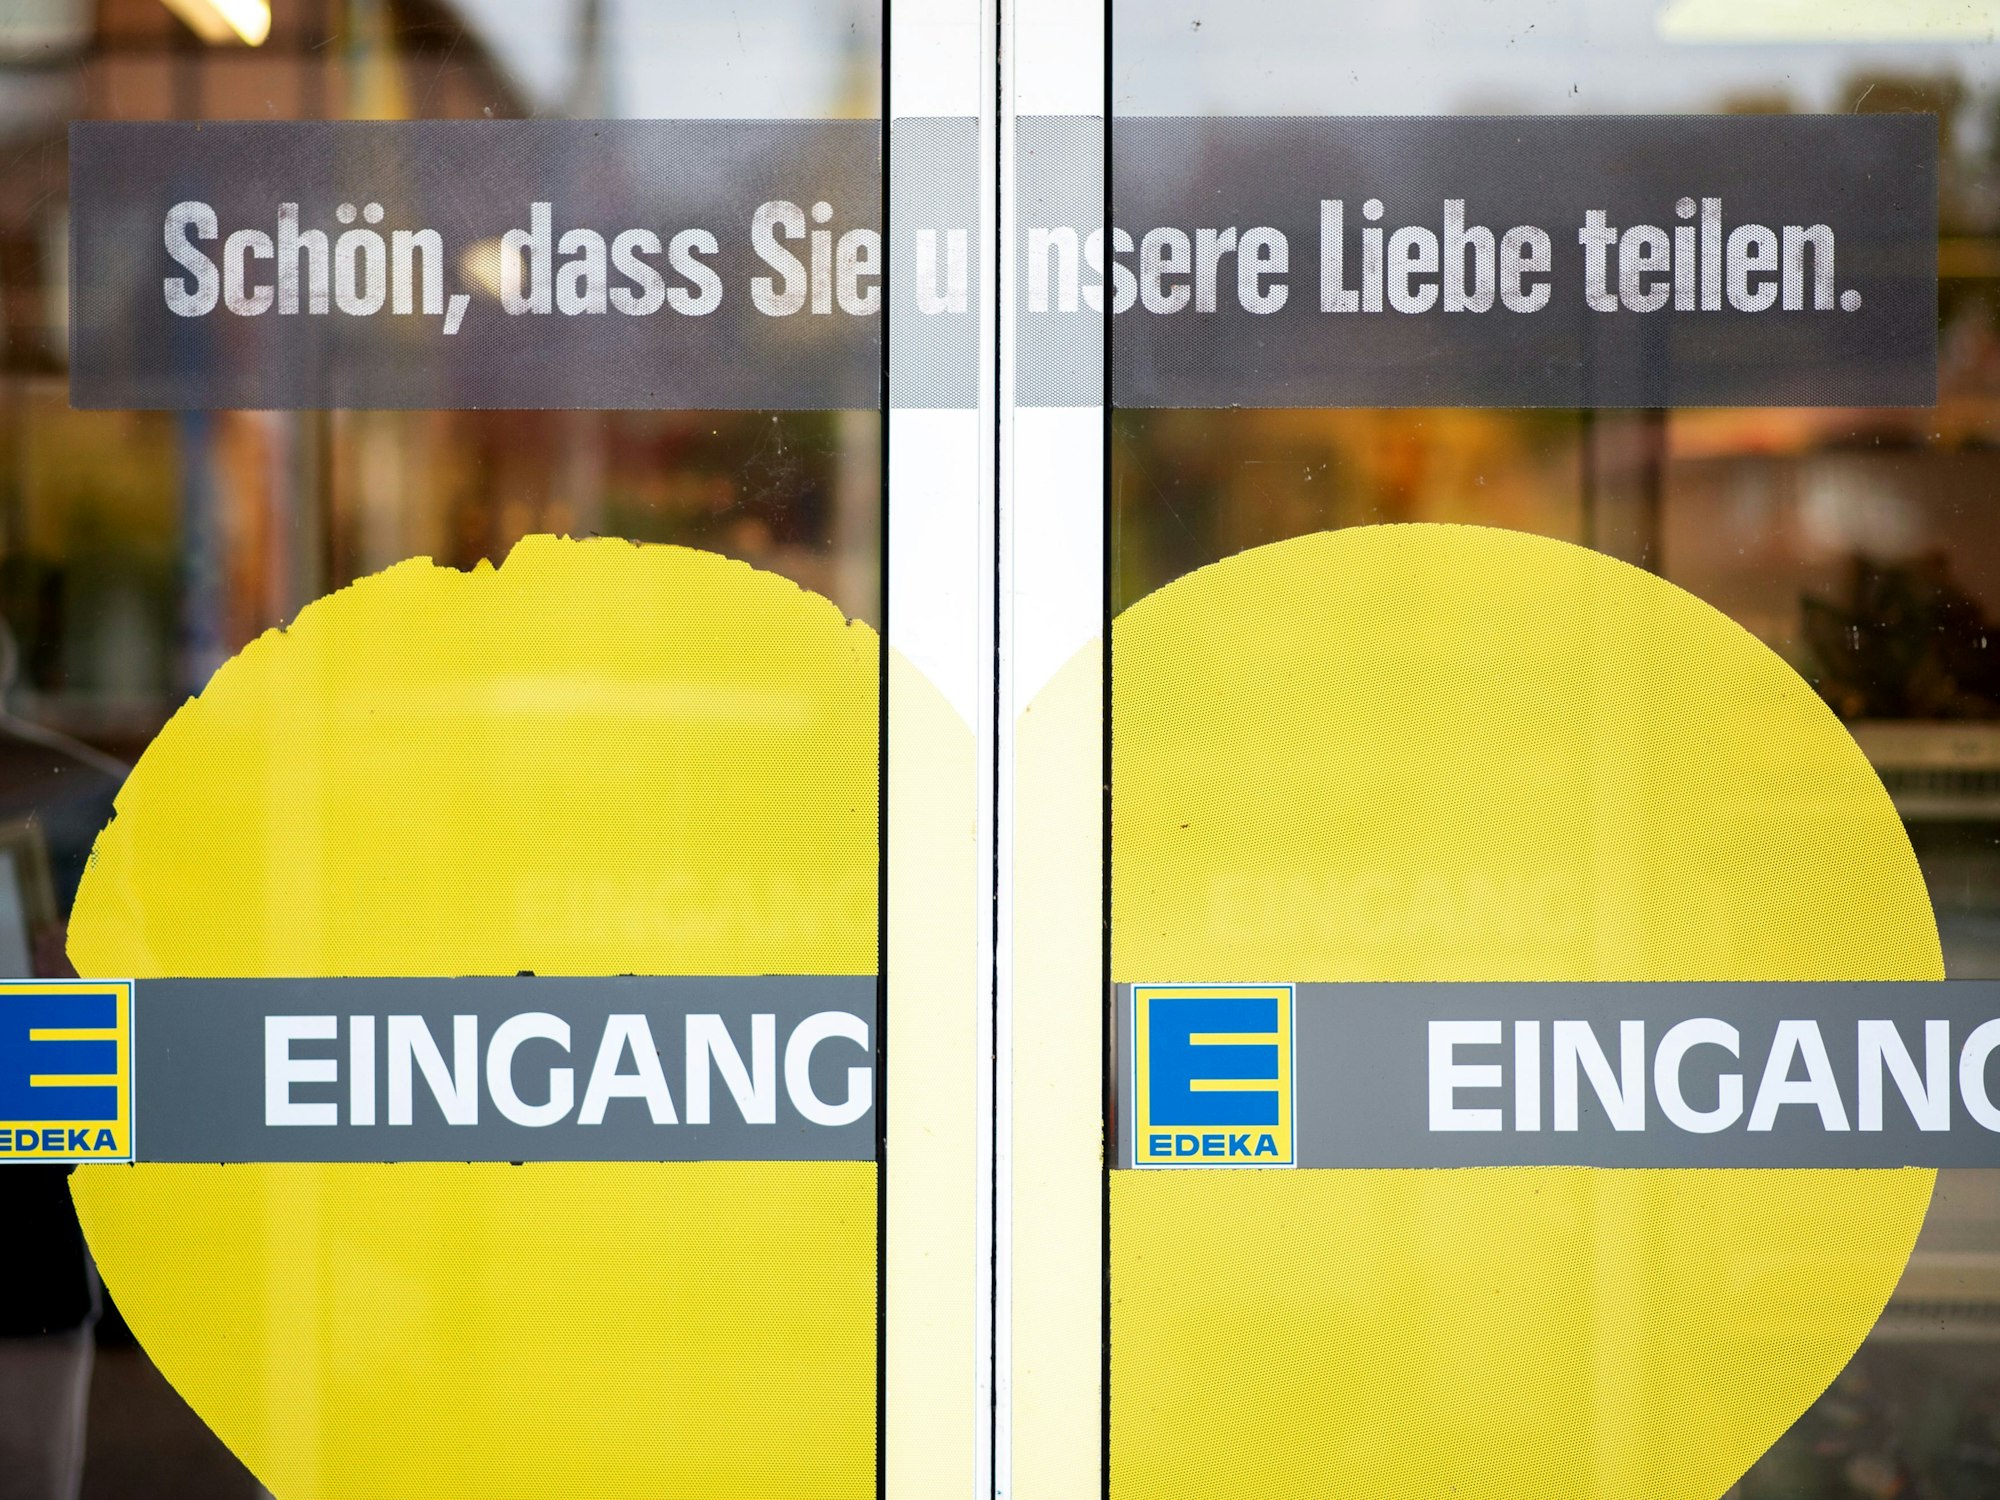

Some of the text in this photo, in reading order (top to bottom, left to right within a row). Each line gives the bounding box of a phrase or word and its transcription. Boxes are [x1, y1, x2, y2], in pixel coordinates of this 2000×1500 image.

[164, 201, 470, 334] Schön,
[500, 202, 722, 316] dass
[751, 200, 881, 316] Sie
[1320, 198, 1552, 314] Liebe
[1578, 196, 1862, 314] teilen.
[265, 1011, 873, 1127] EINGANG
[1149, 1134, 1278, 1157] EDEKA
